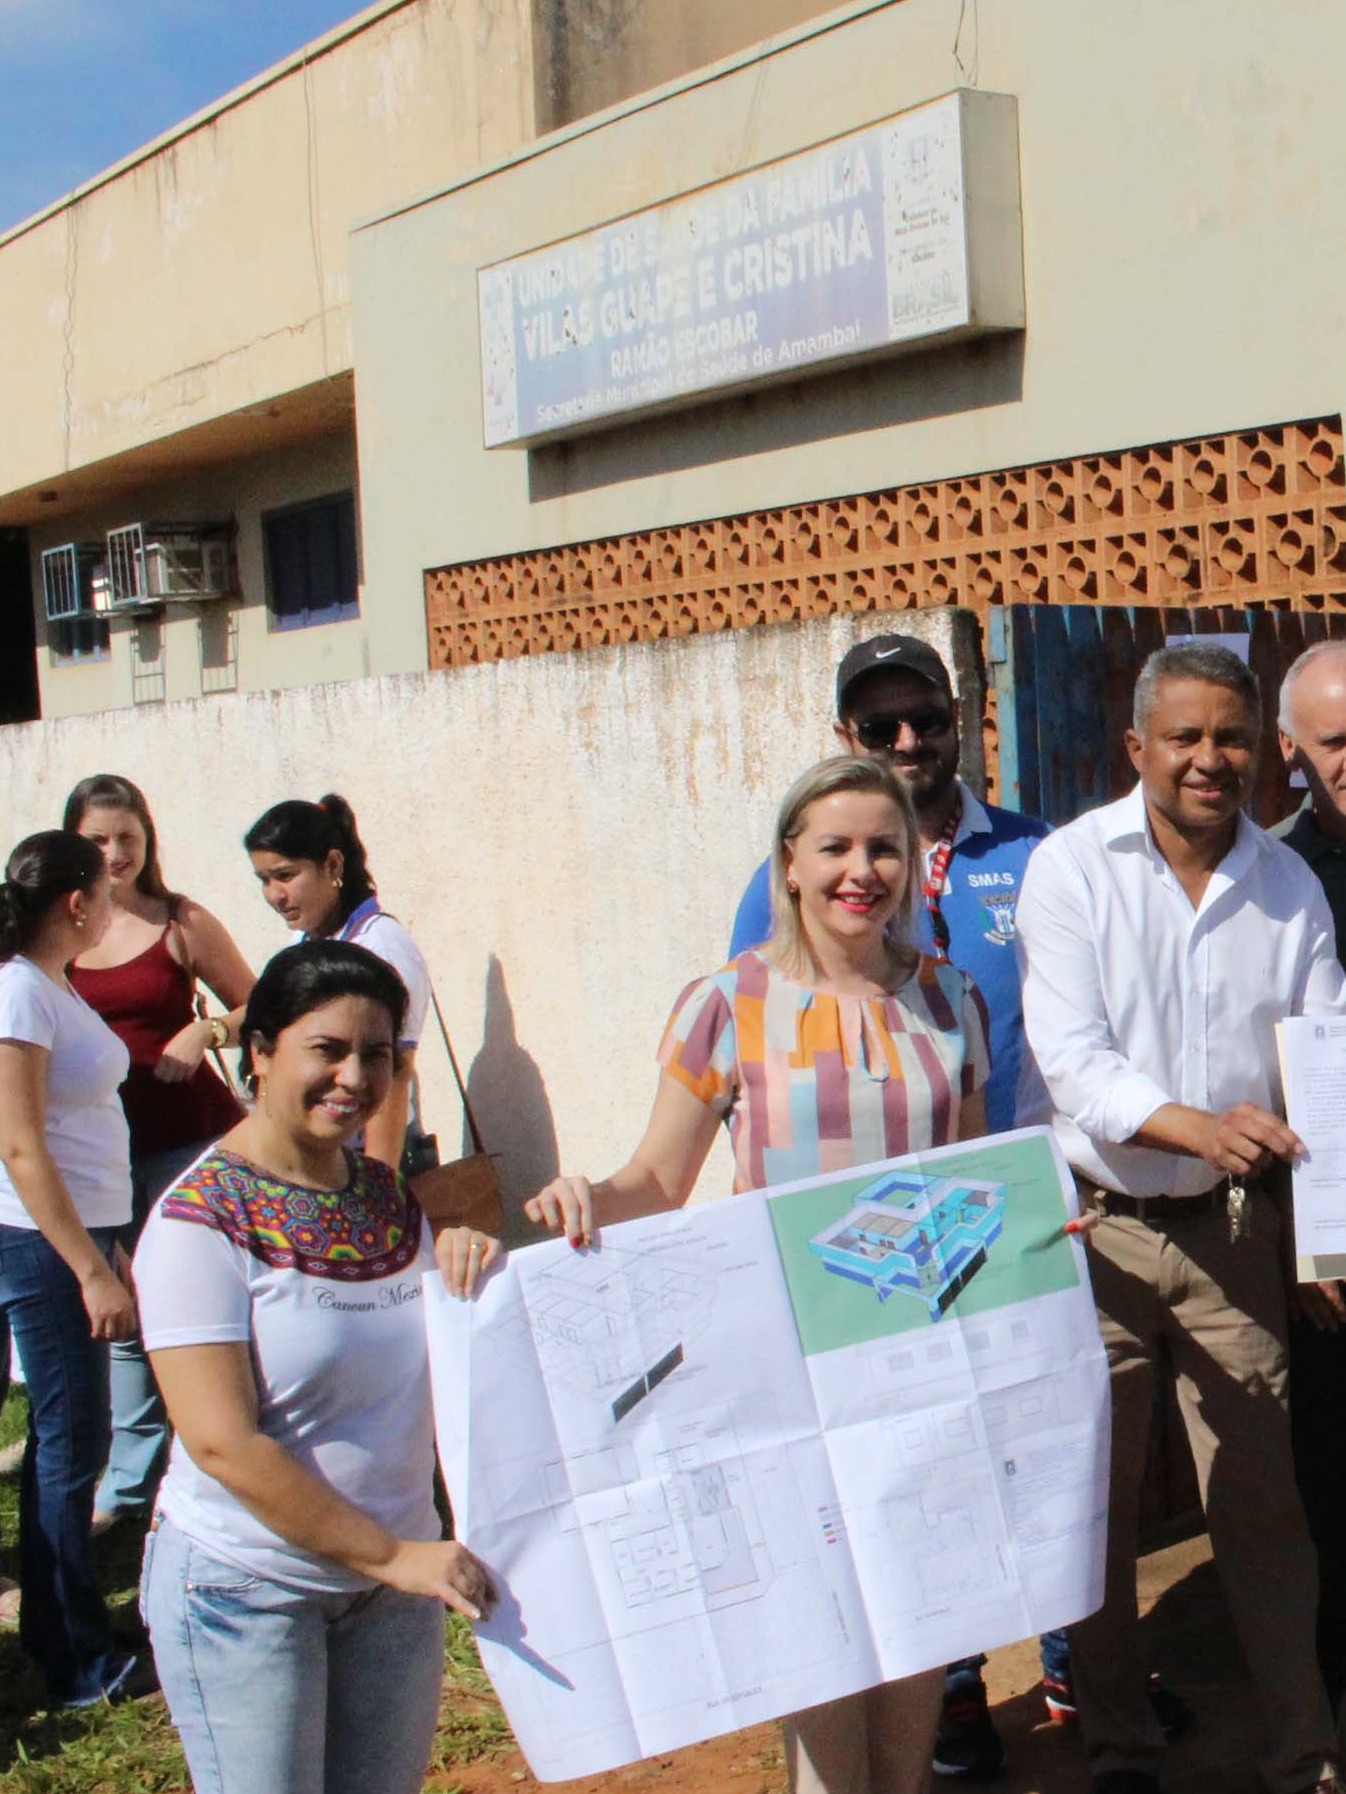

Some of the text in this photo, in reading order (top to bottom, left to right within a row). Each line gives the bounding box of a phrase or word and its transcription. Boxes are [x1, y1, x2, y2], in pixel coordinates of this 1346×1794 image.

[521, 298, 595, 360] VILAS
[697, 255, 717, 309] E
[723, 208, 873, 300] CRISTINA
[753, 344, 774, 368] de
[779, 319, 860, 363] Amambai
[967, 872, 1015, 888] SMAS
